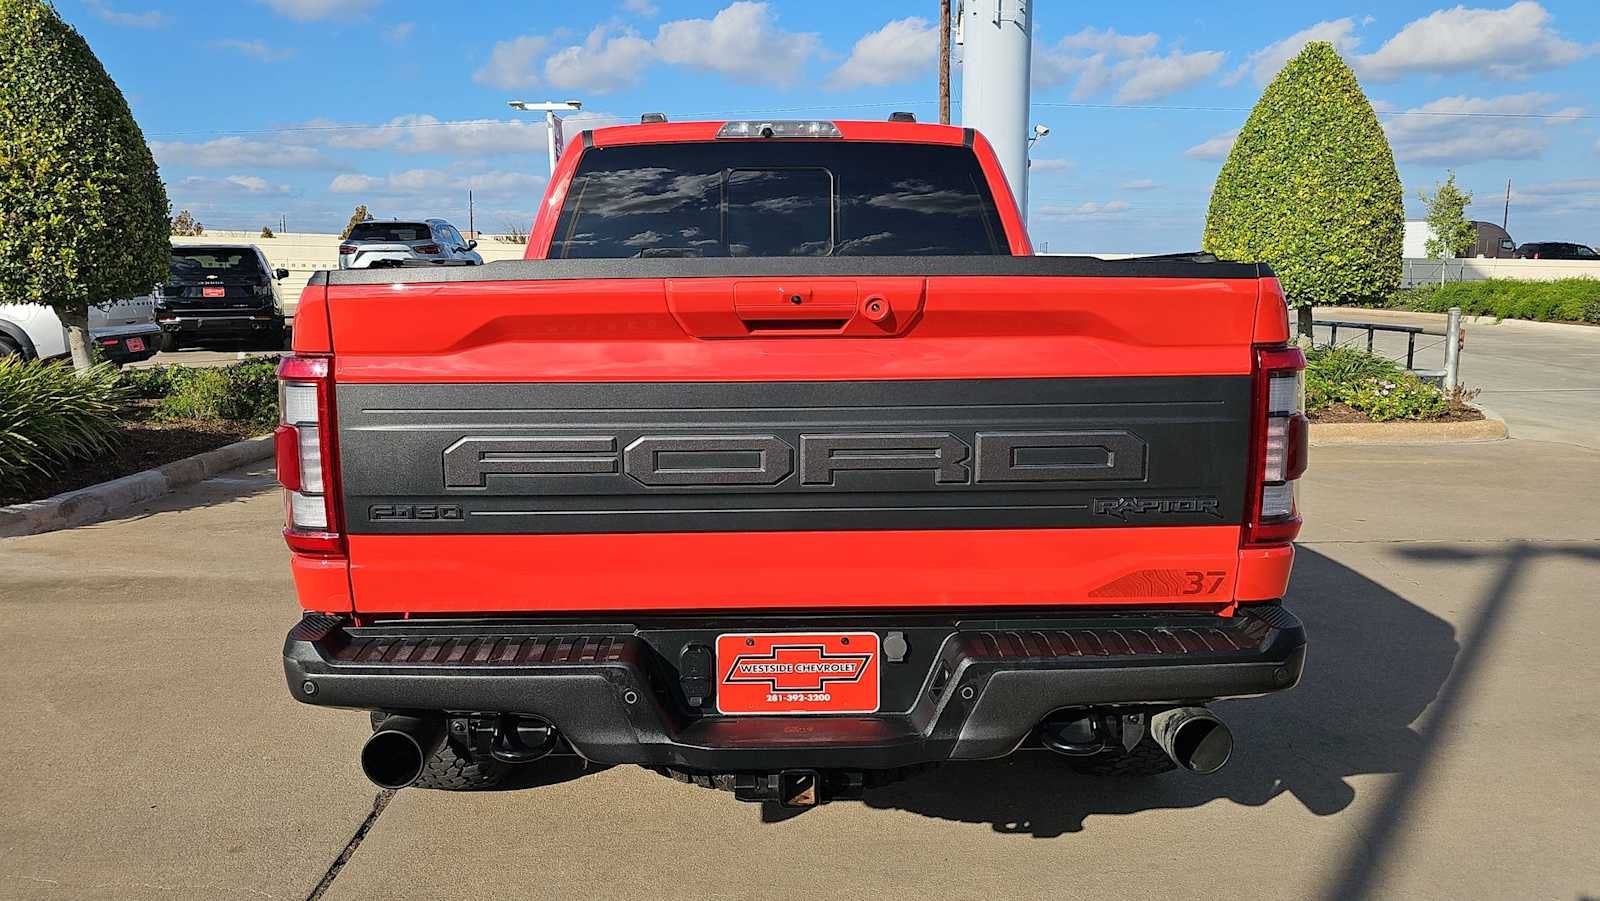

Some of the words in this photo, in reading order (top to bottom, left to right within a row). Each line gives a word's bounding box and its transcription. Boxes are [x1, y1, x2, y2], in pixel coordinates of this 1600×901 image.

[442, 431, 1149, 489] FORD
[1093, 497, 1224, 521] RAPTOR
[1183, 571, 1226, 595] 37
[740, 663, 793, 674] WESTSIDE
[795, 663, 857, 673] CHEVROLET
[765, 693, 831, 703] 281-392-3200
